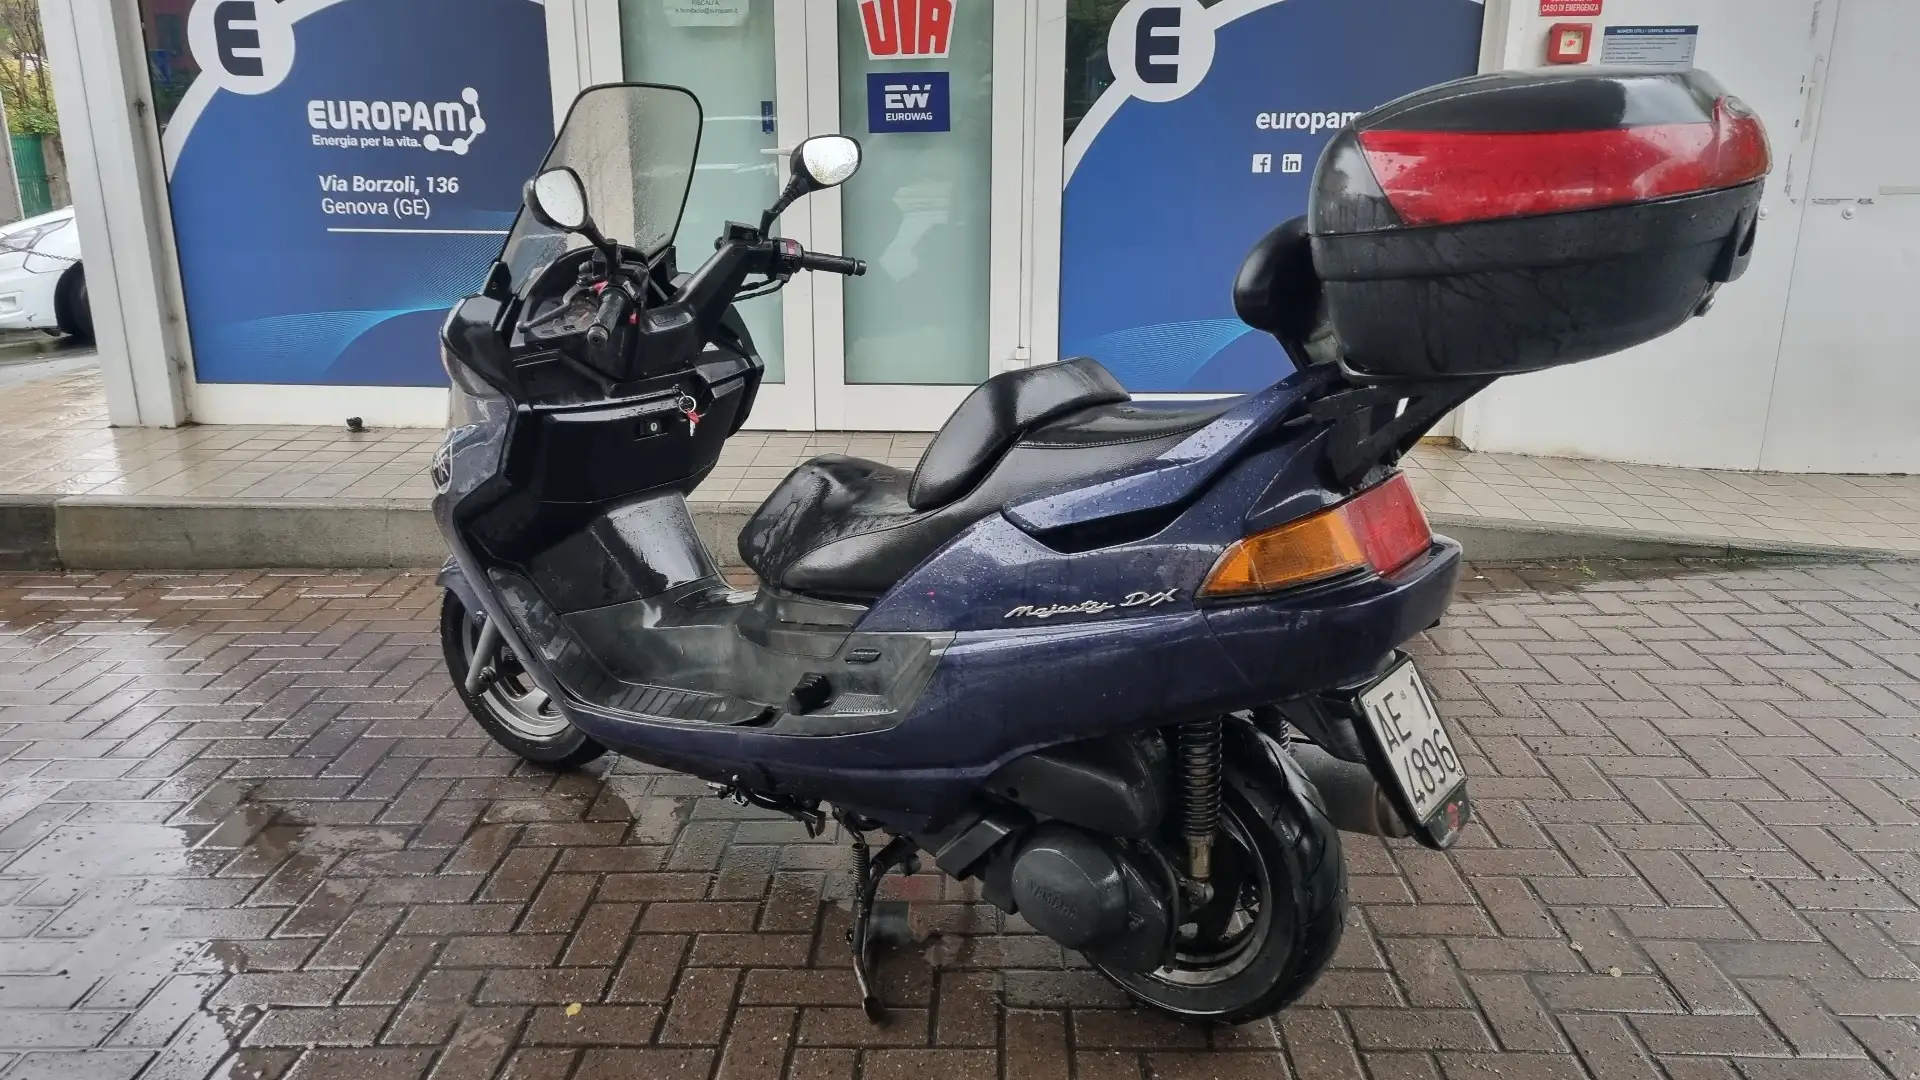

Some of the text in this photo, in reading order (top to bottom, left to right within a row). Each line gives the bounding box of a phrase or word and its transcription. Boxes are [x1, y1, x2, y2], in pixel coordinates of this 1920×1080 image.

[1541, 4, 1599, 12] CASO DI EMERGENZA
[1135, 7, 1181, 84] E
[307, 100, 467, 132] EUROPAM
[885, 112, 933, 121] EUROWAG
[312, 134, 422, 149] Energia per la vita.
[318, 174, 459, 196] Via Borzoli, 136
[321, 197, 430, 220] Genova (GE)
[1004, 587, 1179, 619] Majesty DX
[1373, 691, 1412, 754] AE
[1404, 728, 1457, 805] 4896
